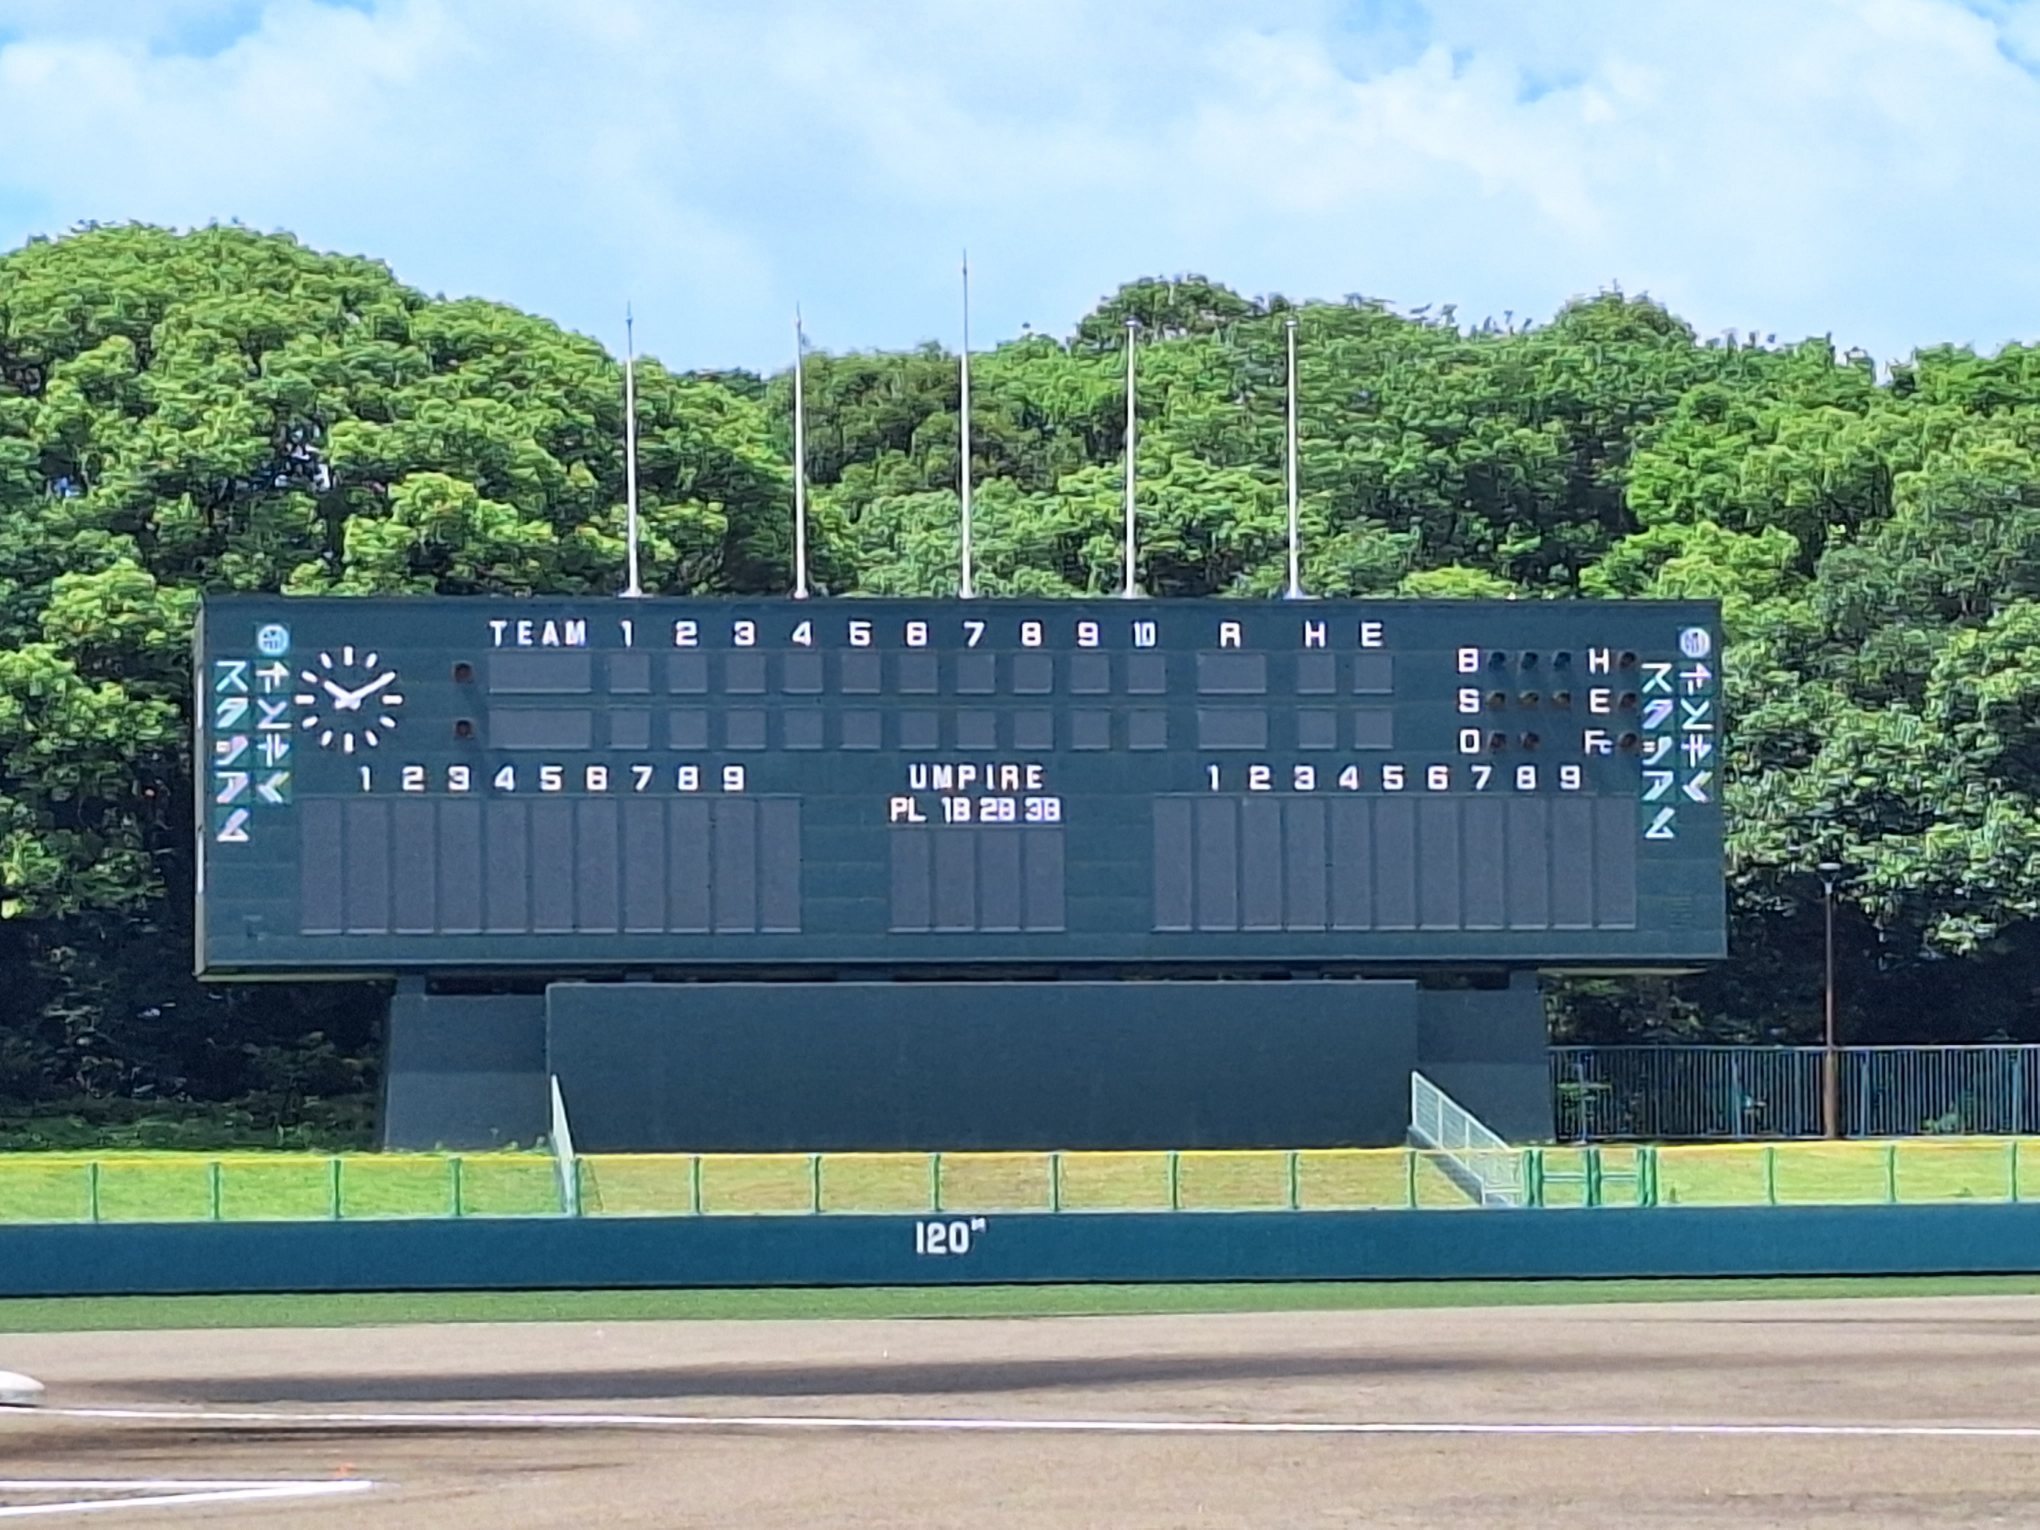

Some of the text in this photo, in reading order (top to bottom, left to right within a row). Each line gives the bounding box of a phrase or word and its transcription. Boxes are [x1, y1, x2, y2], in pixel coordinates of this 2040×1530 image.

[489, 620, 1382, 648] TEAM 1 2 3 4 5 6 7 8 9 10 R H E
[1458, 648, 1610, 674] B H
[1459, 688, 1610, 713] S E
[216, 660, 249, 842] スタジアム
[1641, 663, 1675, 839] スタジアム
[361, 766, 744, 791] 1 2 3 4 5 6 7 8 9
[910, 764, 1043, 790] UMPIRE
[1210, 765, 1580, 791] 1 2 3 4 5 6 7 8 9
[890, 796, 1061, 822] PL 1B 2B 3B
